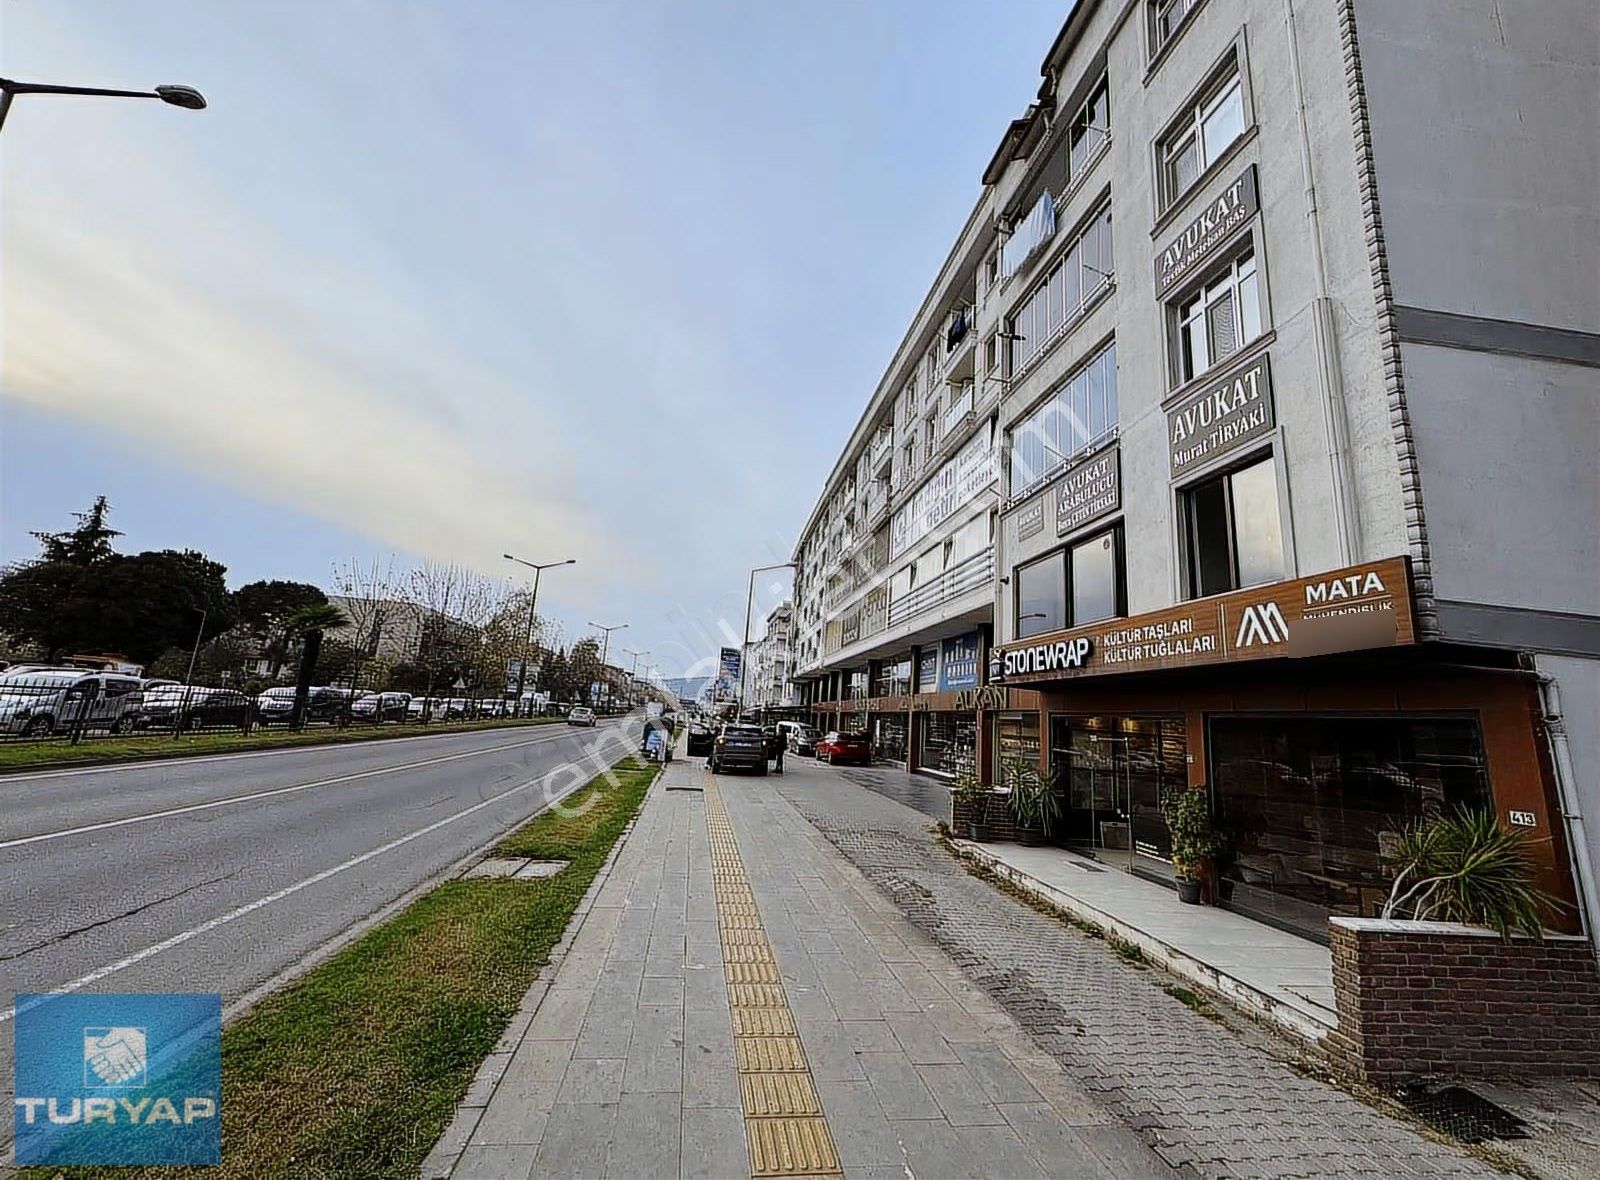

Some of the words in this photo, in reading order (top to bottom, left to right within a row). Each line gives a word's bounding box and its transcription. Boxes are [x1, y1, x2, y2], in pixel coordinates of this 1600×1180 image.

[1162, 179, 1243, 274] AVUKAT
[1172, 365, 1262, 444] AVUKAT
[1173, 439, 1208, 468] Murat
[1209, 402, 1266, 448] TİRYAKİ
[1062, 457, 1110, 499] AVUKAT
[1304, 571, 1386, 605] MATA
[1103, 627, 1142, 647] KÜLTÜR
[1142, 617, 1193, 640] TAŞLARI
[1103, 644, 1142, 664] KÜLTÜR
[1143, 634, 1216, 659] TUĞLALARI
[1004, 637, 1089, 675] STONEWRAP
[1511, 812, 1534, 825] 413
